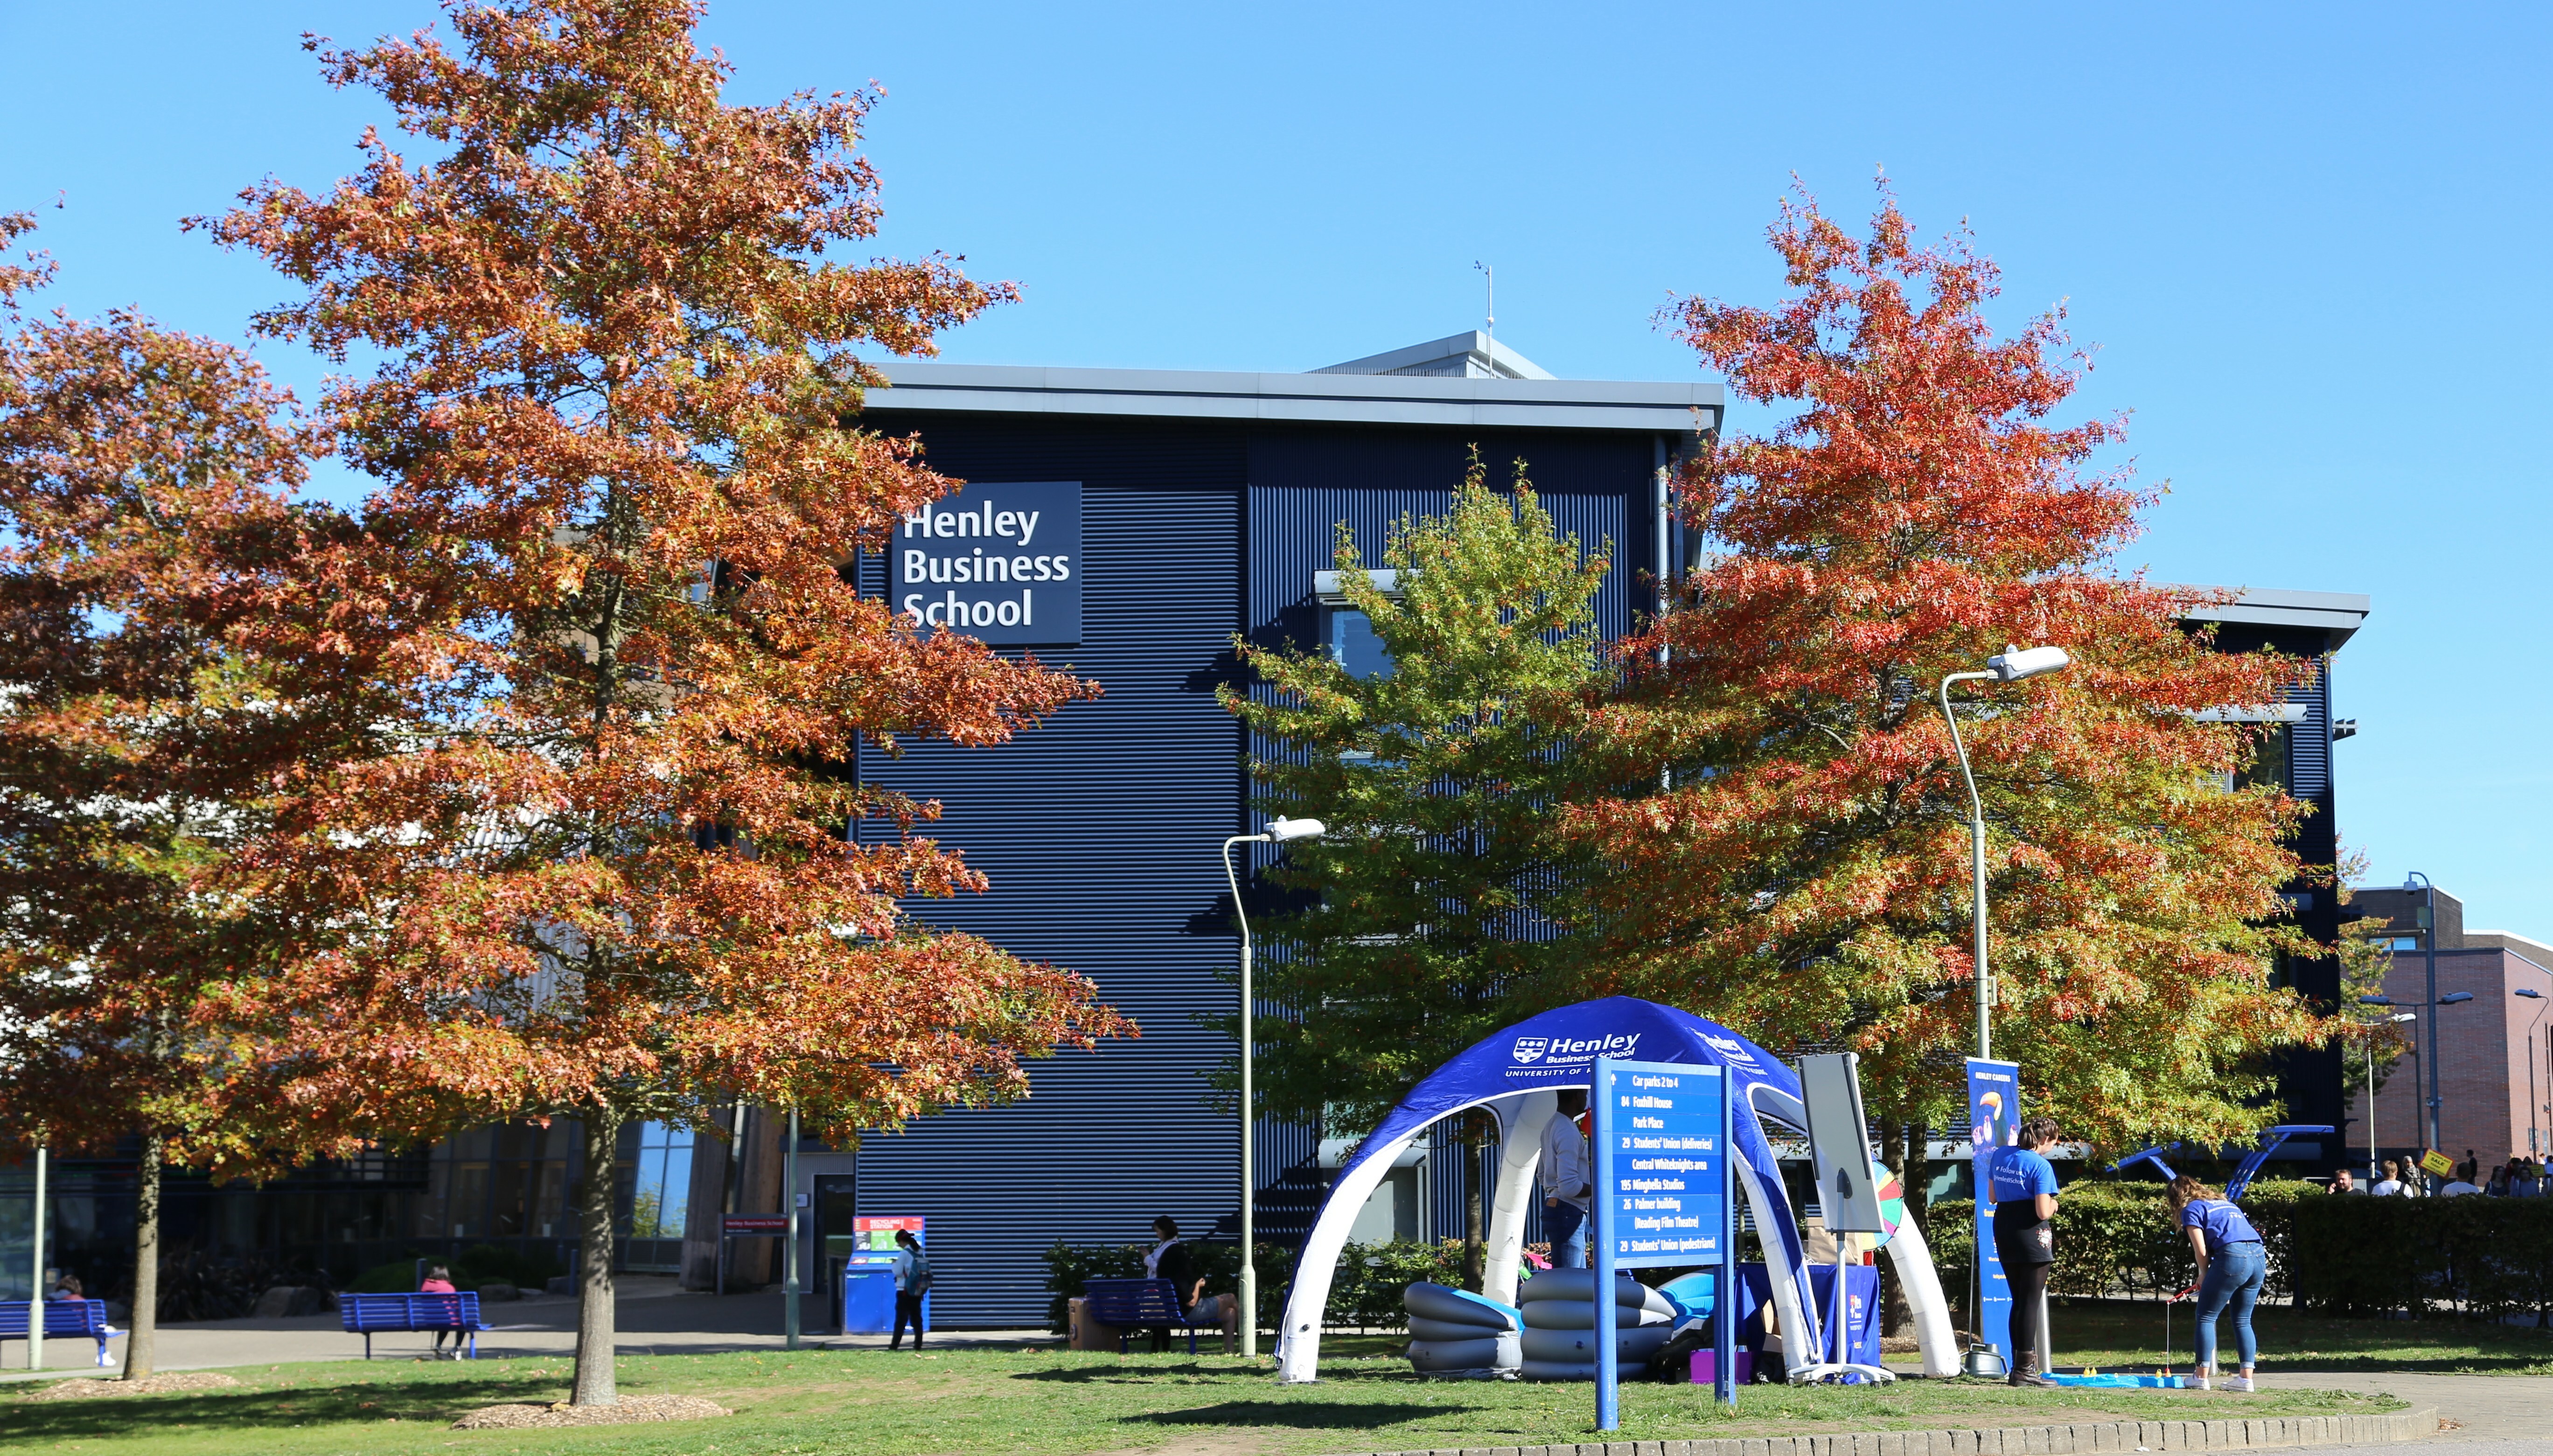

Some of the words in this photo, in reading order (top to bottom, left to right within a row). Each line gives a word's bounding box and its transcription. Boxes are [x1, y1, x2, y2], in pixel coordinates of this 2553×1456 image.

[904, 500, 1039, 546] Henley
[904, 547, 1070, 584] Business
[903, 589, 1031, 627] School
[1549, 1033, 1641, 1053] Henley
[1598, 1047, 1635, 1059] School
[1505, 1069, 1565, 1077] UNIVERSITY
[1975, 1072, 1992, 1080] HENLEY
[1992, 1073, 2011, 1082] CAREERS
[1632, 1075, 1643, 1086] Car
[1644, 1075, 1660, 1090] parks
[1661, 1076, 1666, 1087] 2
[1666, 1077, 1674, 1088] to
[1674, 1077, 1679, 1088] 4
[1621, 1095, 1630, 1107] 84
[1633, 1095, 1653, 1108] Foxhill
[1653, 1097, 1673, 1109] House
[1633, 1116, 1648, 1129] Park
[1648, 1116, 1663, 1129] Place
[1622, 1137, 1631, 1149] 29
[1634, 1136, 1662, 1149] Students'
[1663, 1137, 1681, 1149] Union
[1681, 1137, 1712, 1150] (deliveries)
[1632, 1158, 1654, 1170] Central
[1654, 1158, 1694, 1173] Whiteknights
[1694, 1161, 1707, 1170] area
[2430, 1157, 2445, 1166] SALE
[1620, 1179, 1631, 1191] 195
[1632, 1178, 1662, 1193] Minghella
[1662, 1178, 1685, 1190] Studios
[1623, 1198, 1632, 1210] 26
[1635, 1197, 1656, 1209] Palmer
[1656, 1197, 1681, 1212] building
[1635, 1216, 1660, 1231] (Reading
[1661, 1216, 1674, 1228] Film
[1674, 1215, 1699, 1228] Theatre)
[1620, 1240, 1628, 1252] 29
[1632, 1239, 1660, 1251] Students'
[1661, 1239, 1678, 1251] Union
[1680, 1236, 1716, 1253] (pedestrians)
